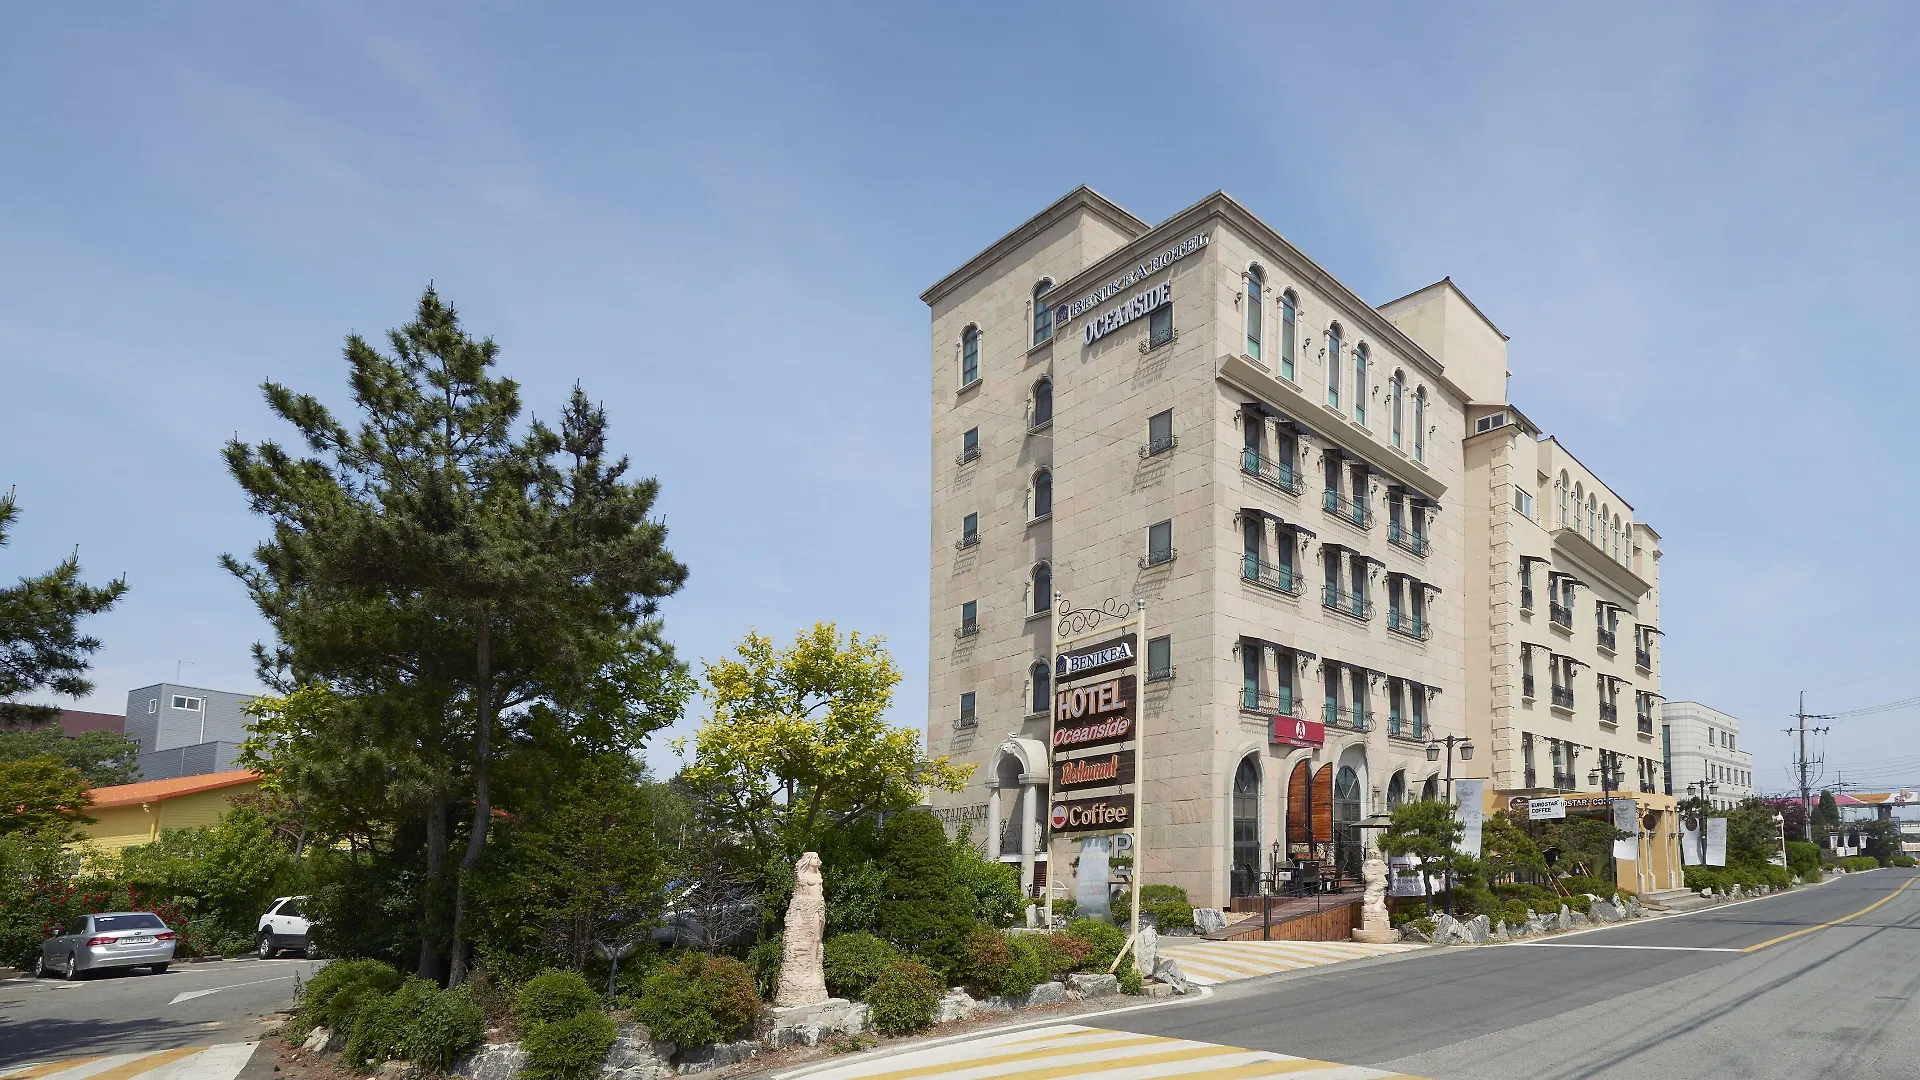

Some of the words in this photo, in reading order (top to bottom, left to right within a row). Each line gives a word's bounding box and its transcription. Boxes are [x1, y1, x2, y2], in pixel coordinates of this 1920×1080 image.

[1071, 264, 1149, 318] BENIKEA
[1150, 232, 1209, 272] HOTEL
[1084, 279, 1171, 345] OCEANSIDE
[1070, 642, 1134, 671] BENIKEA
[1057, 680, 1126, 721] HOTEL
[1053, 717, 1130, 746] Oceanside
[1061, 754, 1118, 785] Restaurant
[1069, 803, 1128, 826] Coffee
[1531, 800, 1558, 808] EUROSTAR
